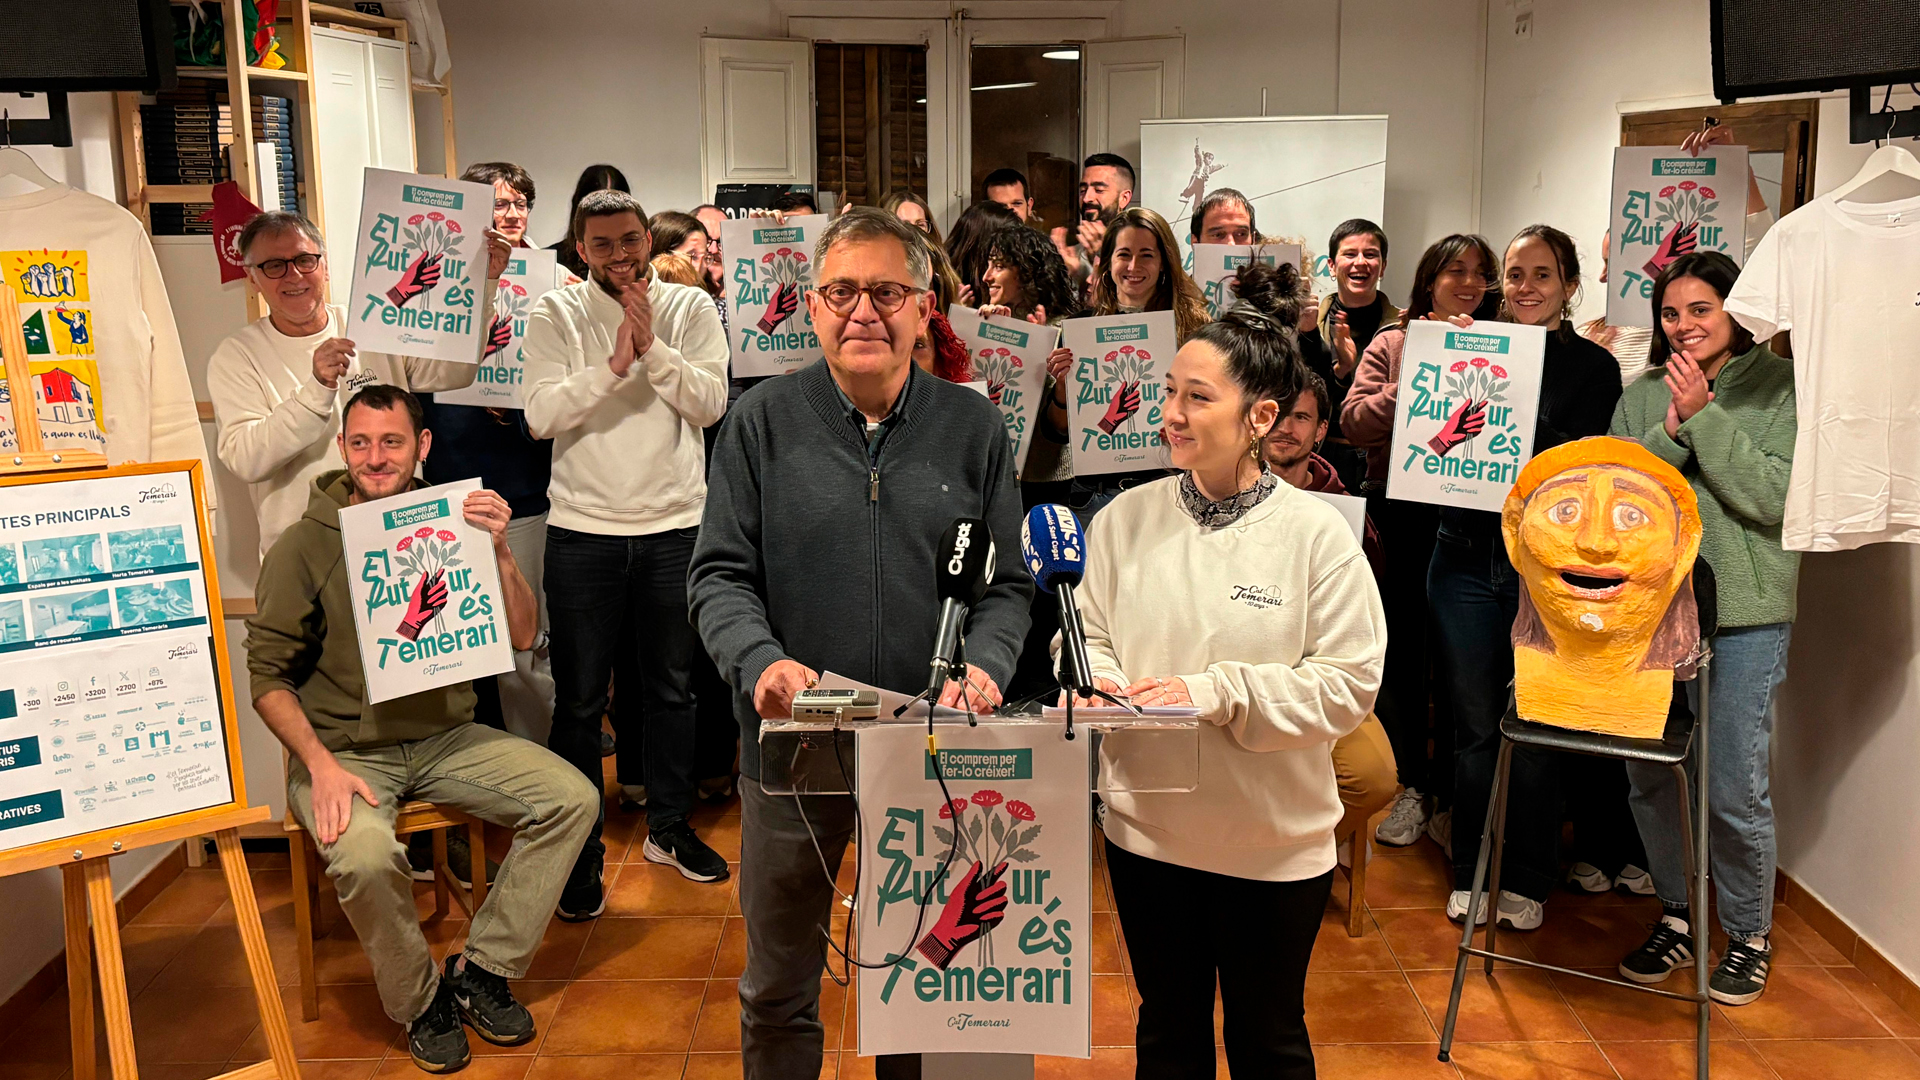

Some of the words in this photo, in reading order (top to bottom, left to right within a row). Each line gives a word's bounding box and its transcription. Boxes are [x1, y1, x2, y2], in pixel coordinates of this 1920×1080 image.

[358, 4, 380, 14] 75
[1622, 190, 1650, 219] El
[370, 212, 400, 243] El
[734, 258, 756, 283] El
[444, 275, 474, 308] és
[361, 294, 472, 335] Temerari
[741, 328, 823, 352] Temera
[1076, 357, 1098, 382] El
[1411, 361, 1441, 392] El
[1147, 395, 1166, 425] é
[50, 432, 76, 440] quan
[1081, 427, 1161, 452] Temera
[1488, 423, 1521, 456] és
[1403, 443, 1519, 484] Temerari
[139, 491, 177, 503] Temerari
[35, 505, 131, 526] PRINCIPALS
[948, 523, 972, 575] Cugat
[362, 549, 391, 582] El
[459, 582, 492, 621] és
[1230, 585, 1283, 606] Temerari
[1249, 585, 1263, 594] Cal
[377, 616, 498, 670] Temerari
[53, 693, 76, 702] +2450
[85, 688, 106, 697] +3200
[116, 683, 136, 692] +2700
[940, 752, 947, 764] El
[950, 754, 998, 767] comprem
[1000, 754, 1017, 767] per
[942, 764, 972, 777] fer-lo
[974, 764, 1015, 777] créixer!
[877, 807, 924, 858] El
[1018, 896, 1072, 955] és
[880, 952, 1072, 1005] Temerari
[957, 1013, 1011, 1031] Temerari
